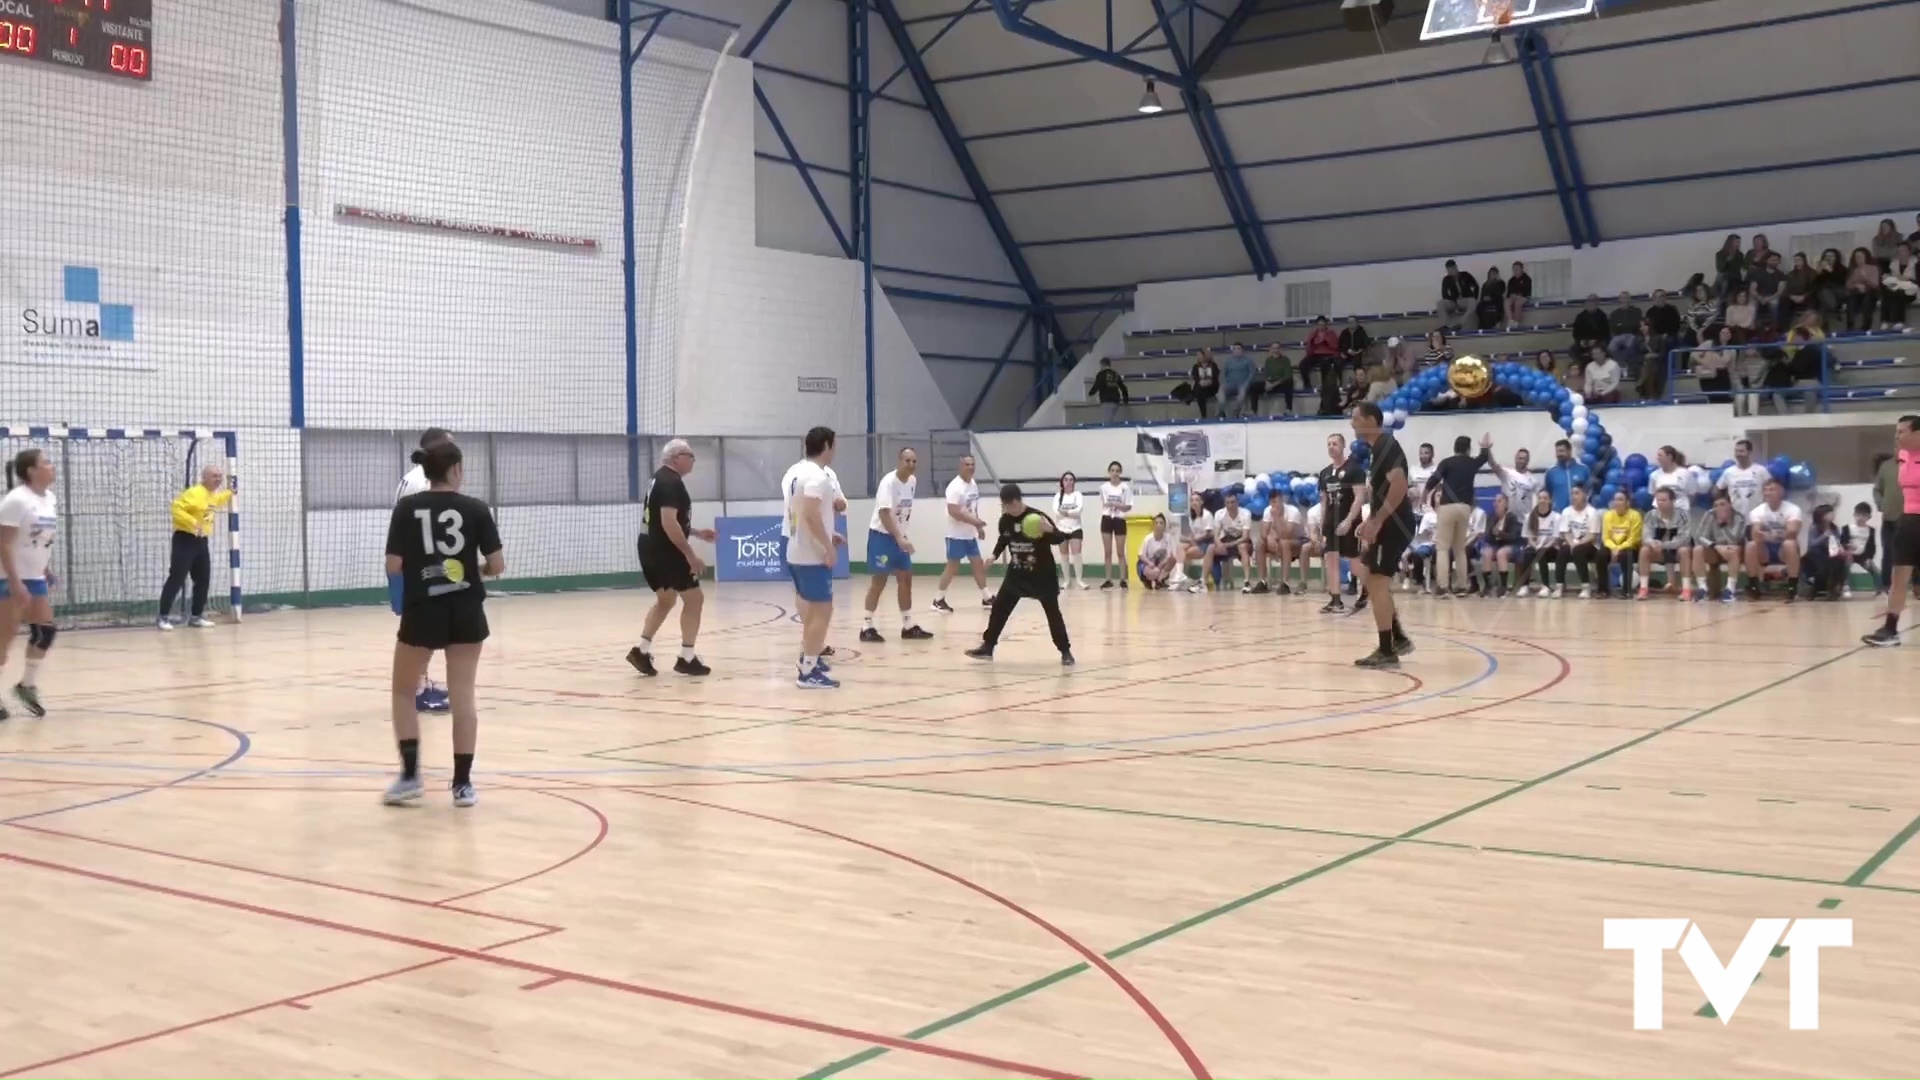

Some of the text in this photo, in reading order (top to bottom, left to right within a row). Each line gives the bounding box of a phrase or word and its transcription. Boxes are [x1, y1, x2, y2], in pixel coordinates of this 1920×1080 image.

[101, 20, 145, 42] VISITANTE
[110, 43, 145, 74] 00
[22, 308, 100, 338] Suma
[413, 507, 466, 557] 13
